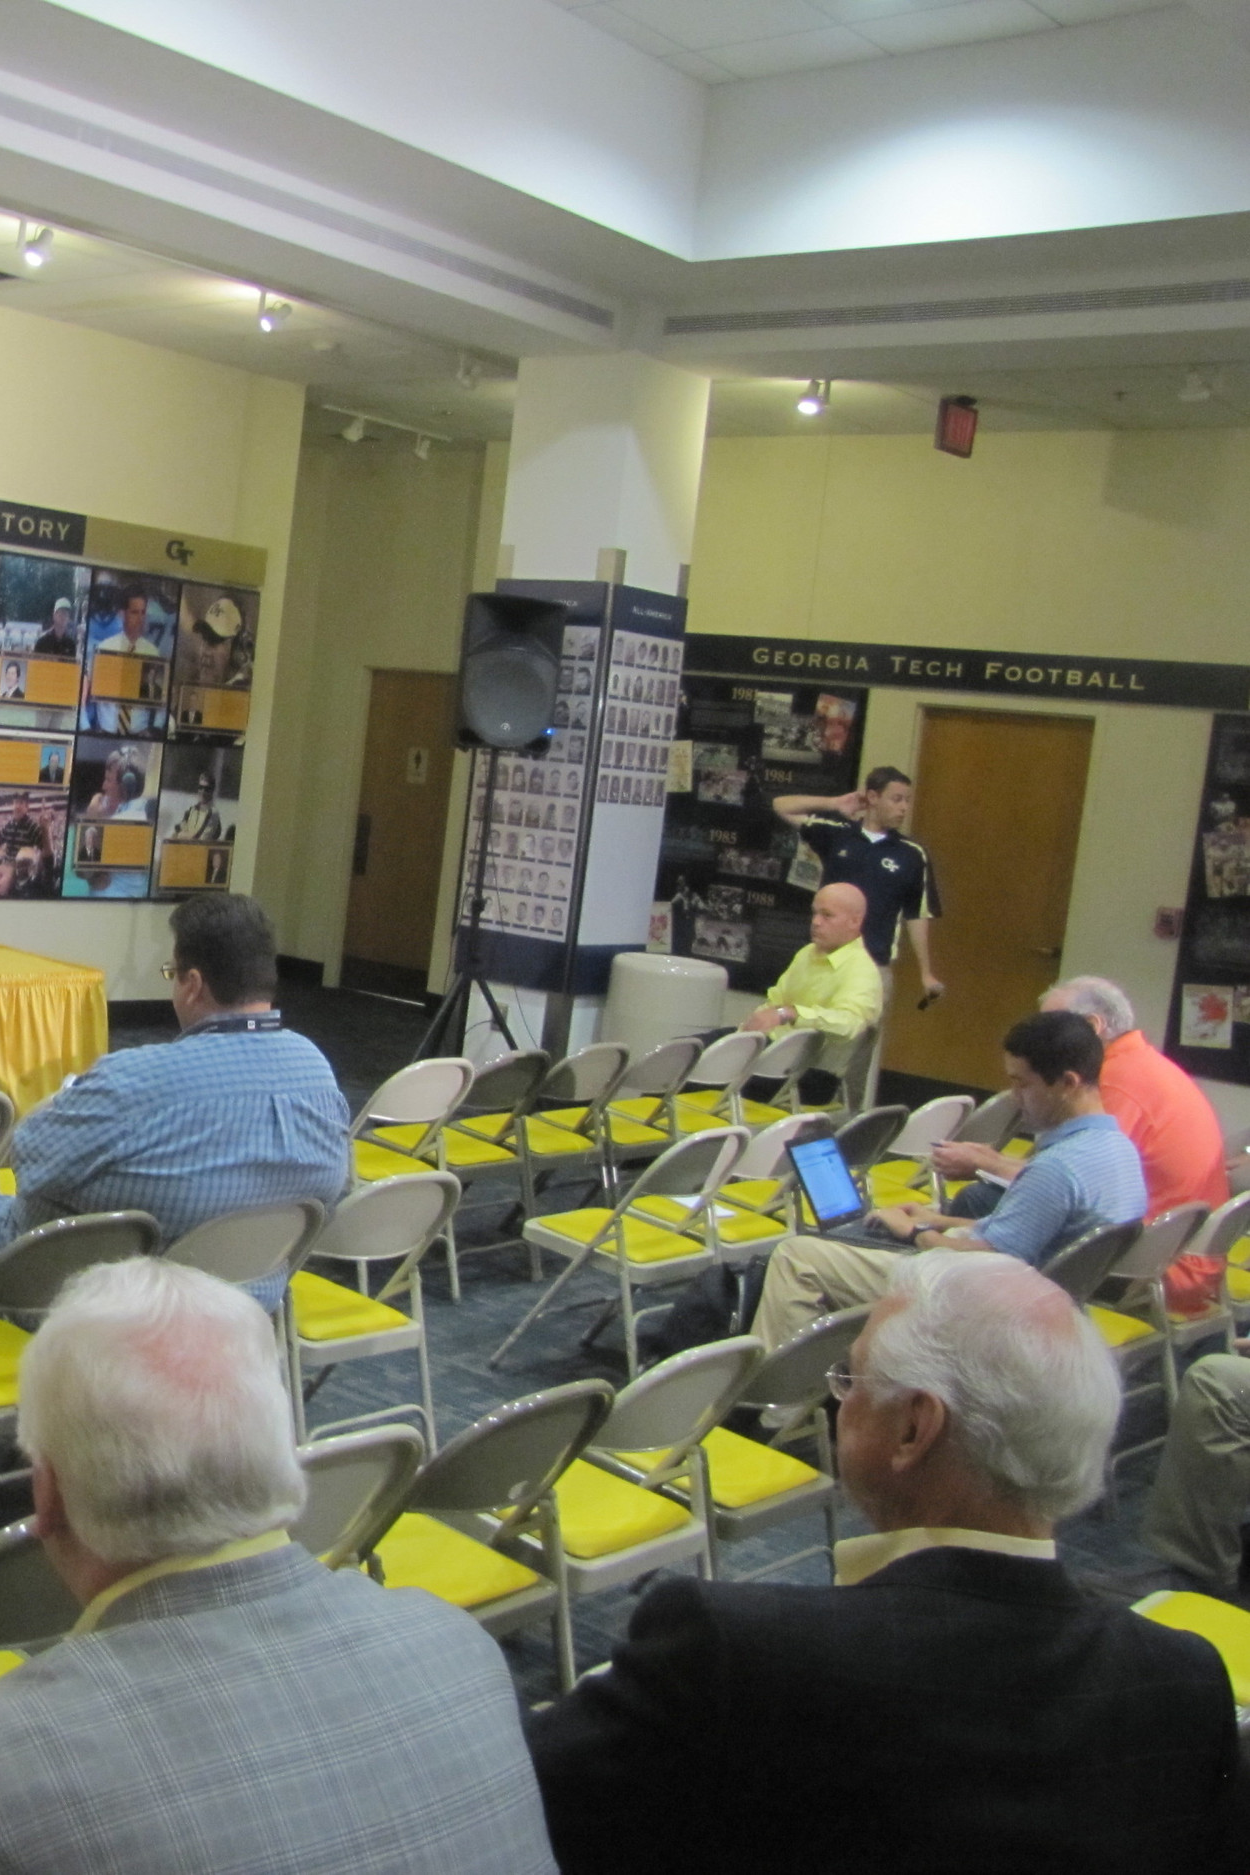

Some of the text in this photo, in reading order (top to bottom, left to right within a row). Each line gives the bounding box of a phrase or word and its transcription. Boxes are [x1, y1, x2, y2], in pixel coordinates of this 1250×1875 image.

[753, 648, 1145, 691] GEORGIA TECH FOOTBALL
[765, 769, 792, 783] 1984
